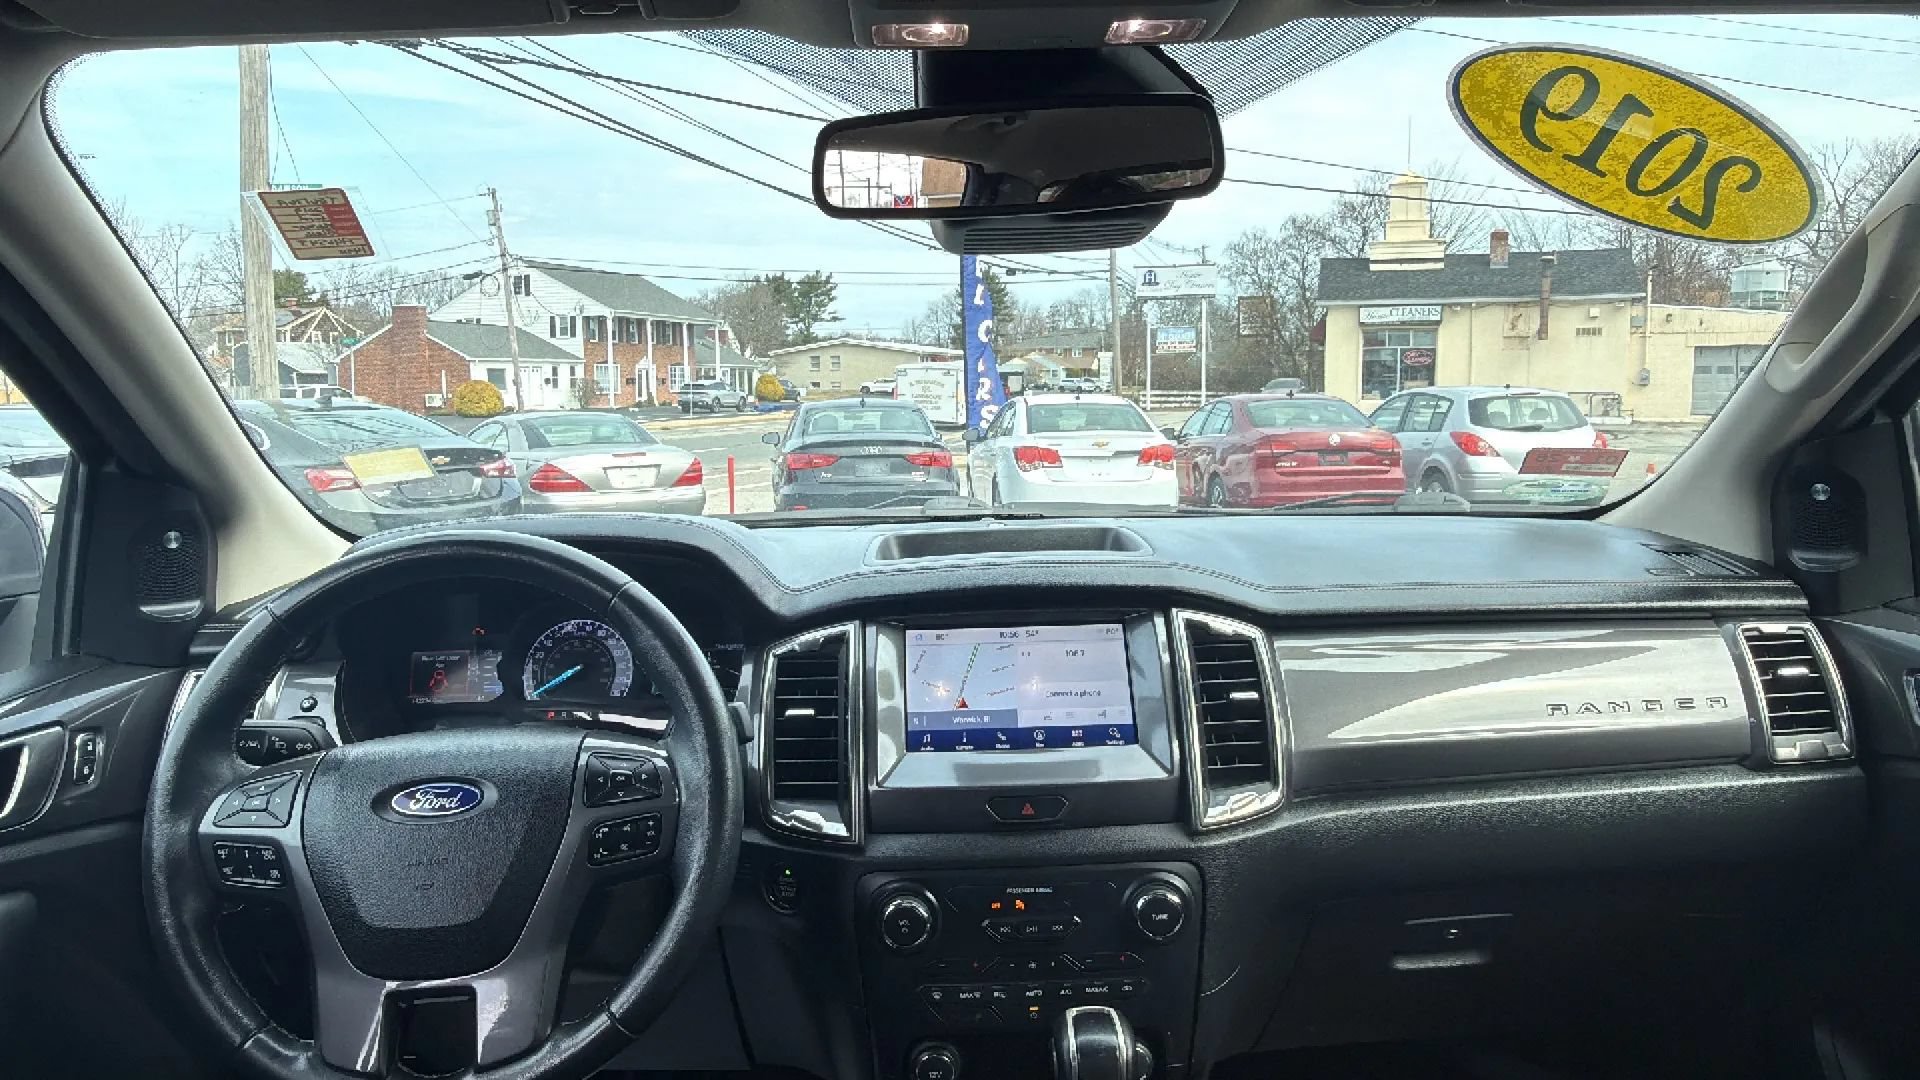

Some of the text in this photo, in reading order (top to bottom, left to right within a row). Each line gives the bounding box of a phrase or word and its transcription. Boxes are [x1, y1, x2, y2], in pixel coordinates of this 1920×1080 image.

[1545, 696, 1729, 717] RANGER
[409, 787, 463, 811] Ford
[1151, 913, 1169, 921] TUNE
